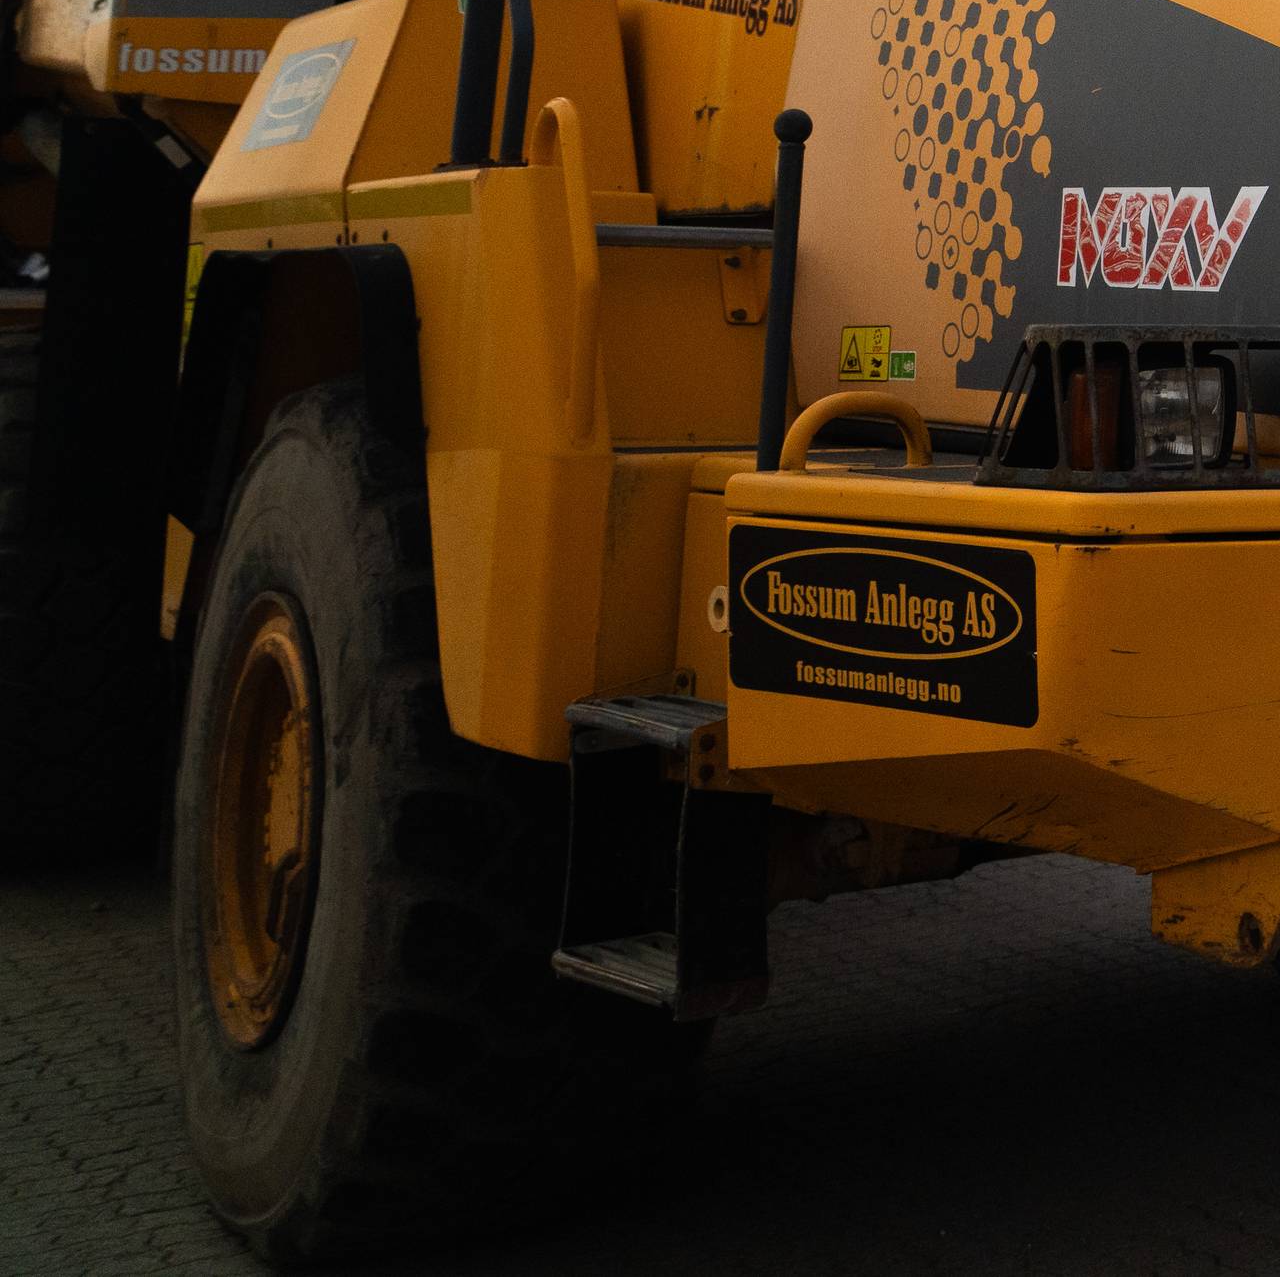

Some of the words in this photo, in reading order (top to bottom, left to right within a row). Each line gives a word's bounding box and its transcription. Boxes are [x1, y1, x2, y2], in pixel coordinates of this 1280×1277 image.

[118, 42, 267, 73] fossum
[1057, 186, 1269, 292] MOXY
[766, 571, 857, 622] Fossum
[864, 580, 955, 646] Anlegg
[962, 591, 997, 640] AS
[795, 660, 962, 705] fossumanlegg.no
